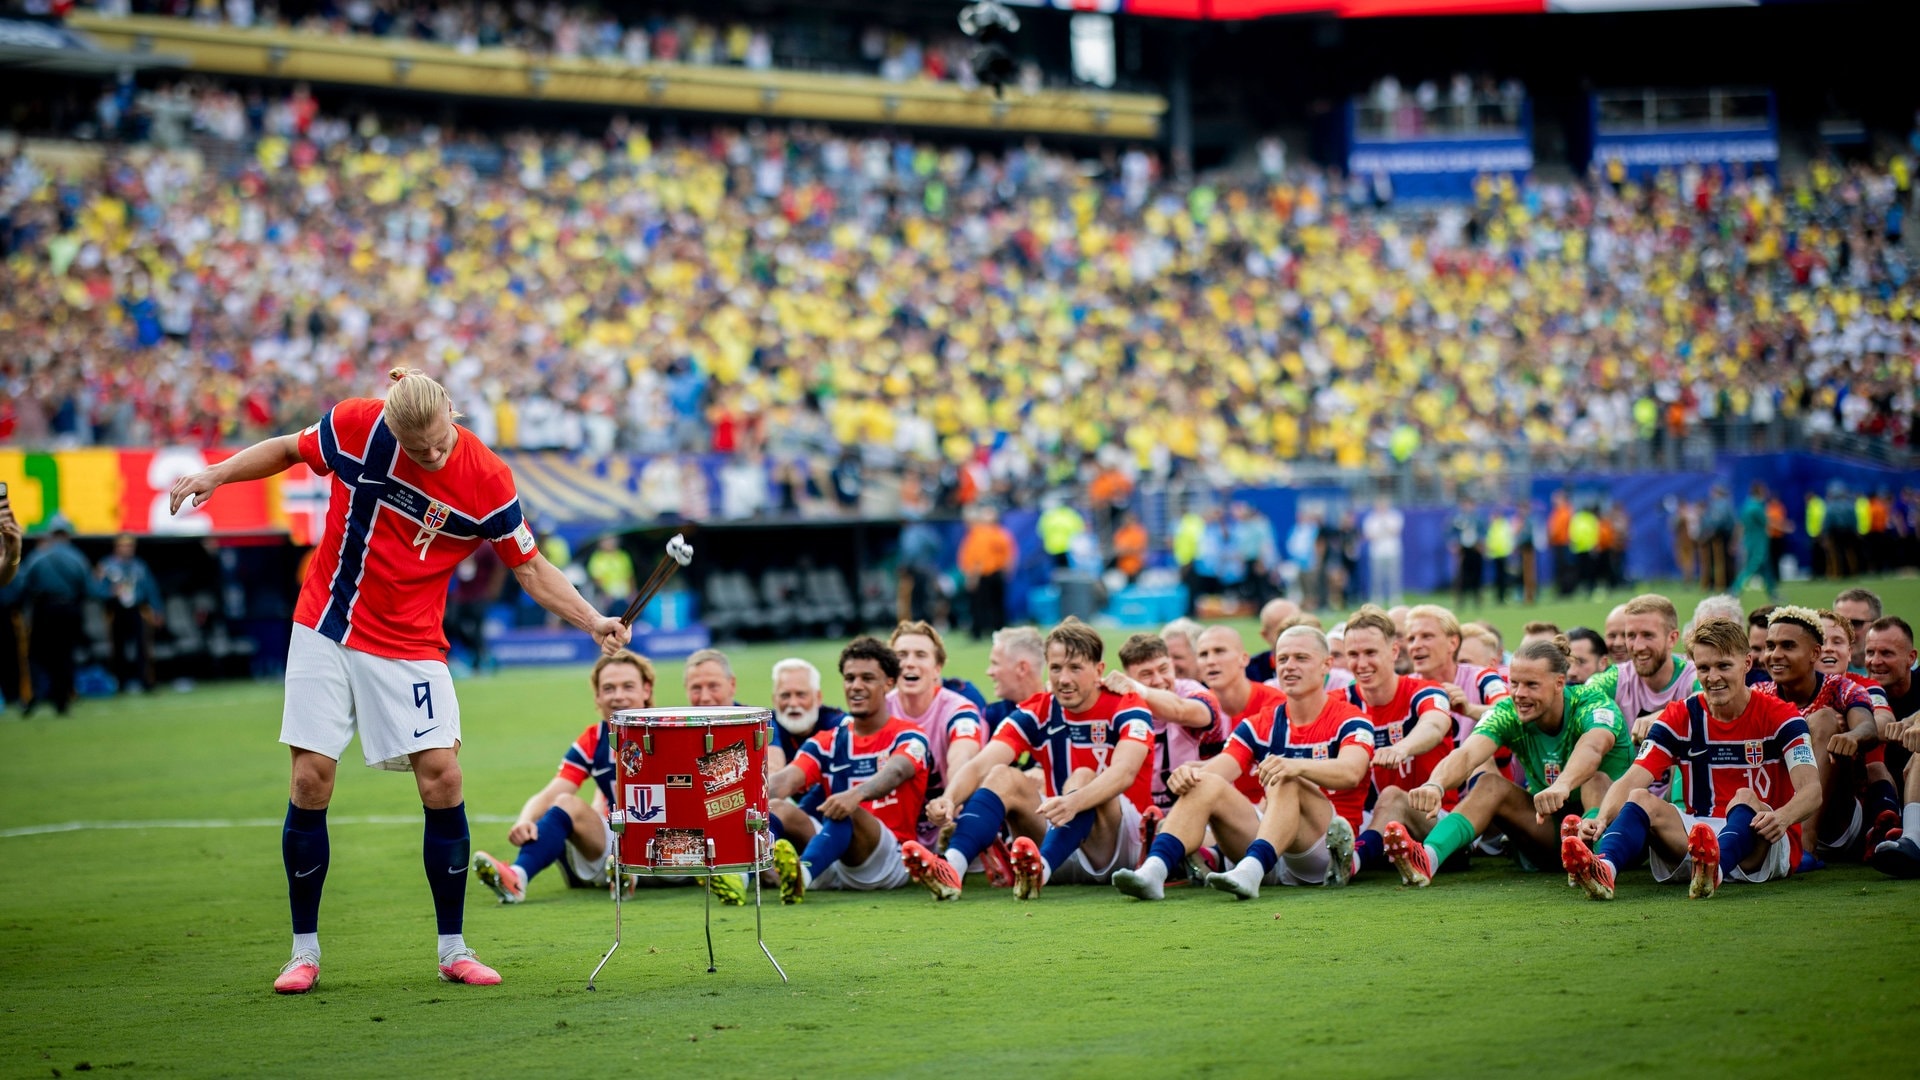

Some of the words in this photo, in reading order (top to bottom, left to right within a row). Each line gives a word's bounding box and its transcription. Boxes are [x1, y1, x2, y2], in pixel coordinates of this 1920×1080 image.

[147, 446, 214, 535] 2
[412, 528, 438, 561] 9
[412, 681, 434, 719] 9
[1743, 766, 1771, 798] 10
[705, 801, 720, 816] 19
[731, 791, 746, 808] 26
